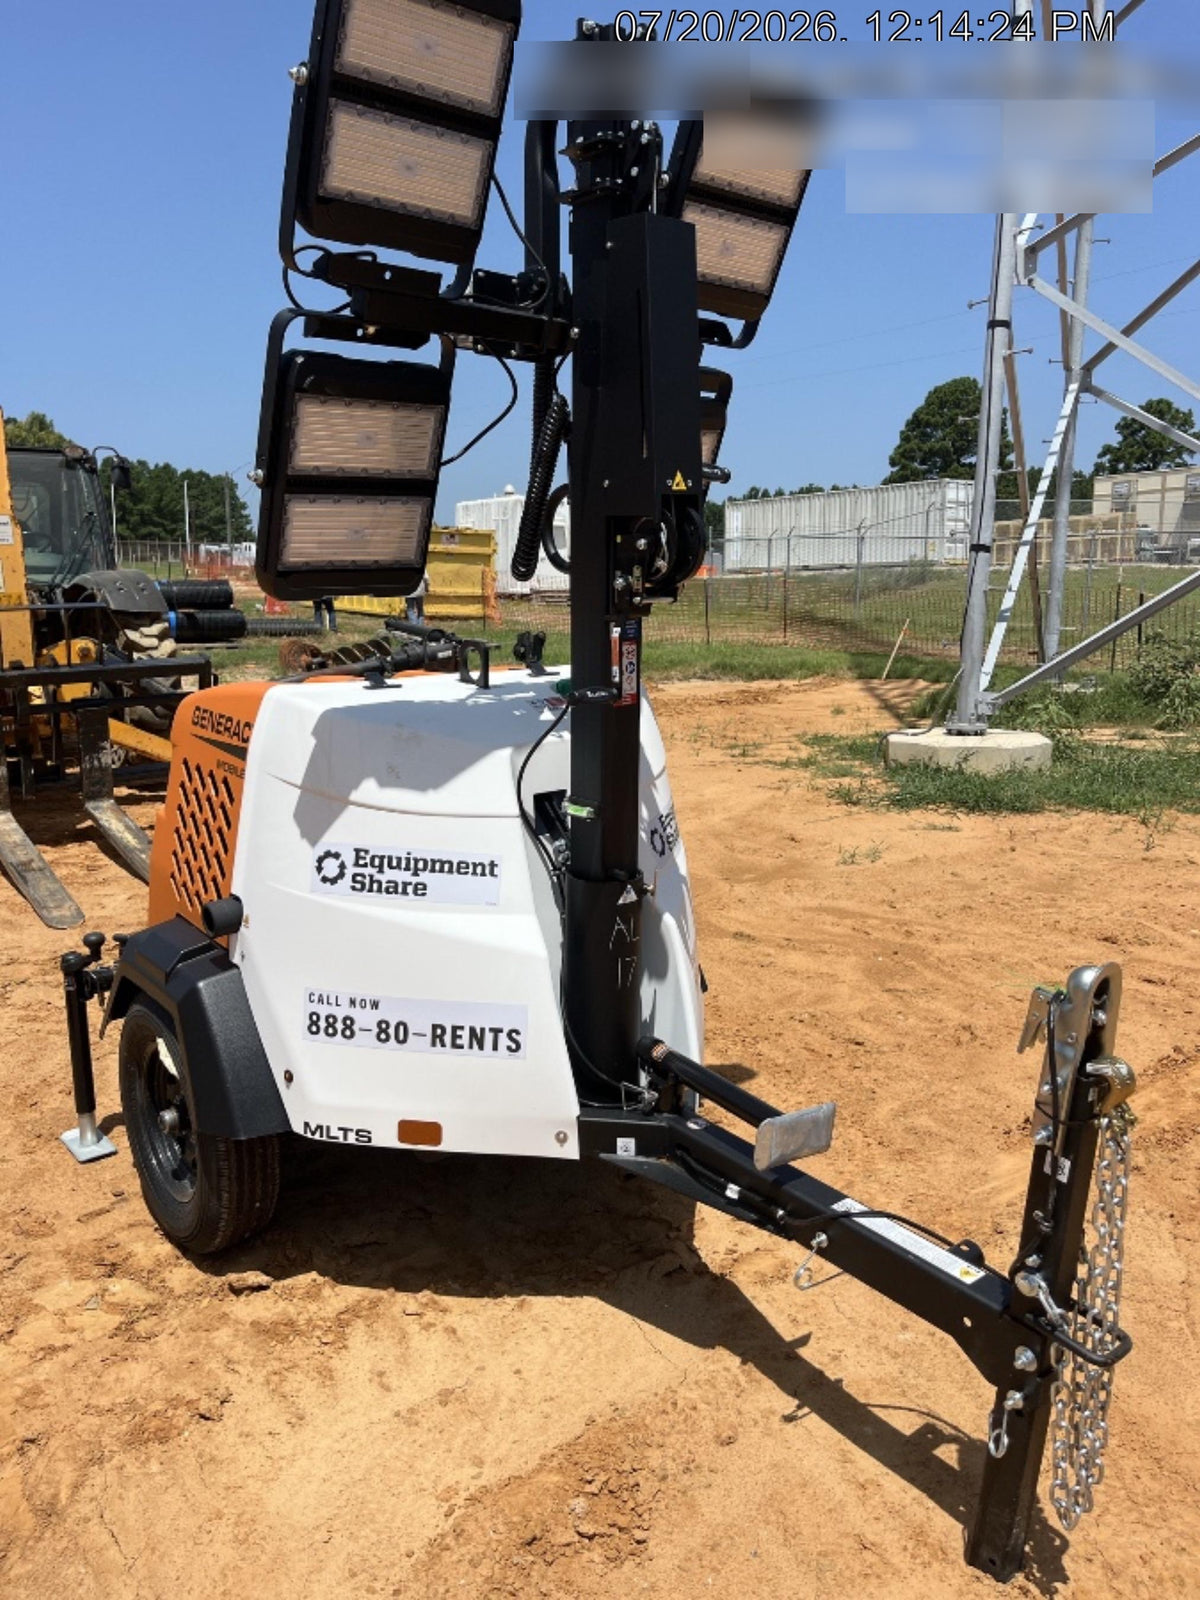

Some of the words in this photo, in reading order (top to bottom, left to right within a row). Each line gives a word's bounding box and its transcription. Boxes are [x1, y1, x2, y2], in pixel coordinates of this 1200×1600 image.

[192, 705, 252, 743] GENERAC
[353, 848, 499, 878] Equipment
[350, 872, 428, 897] Share
[308, 991, 342, 1007] CALL
[349, 996, 381, 1011] NOW
[307, 1011, 523, 1053] 888-80-RENTS
[303, 1121, 372, 1144] MLTS
